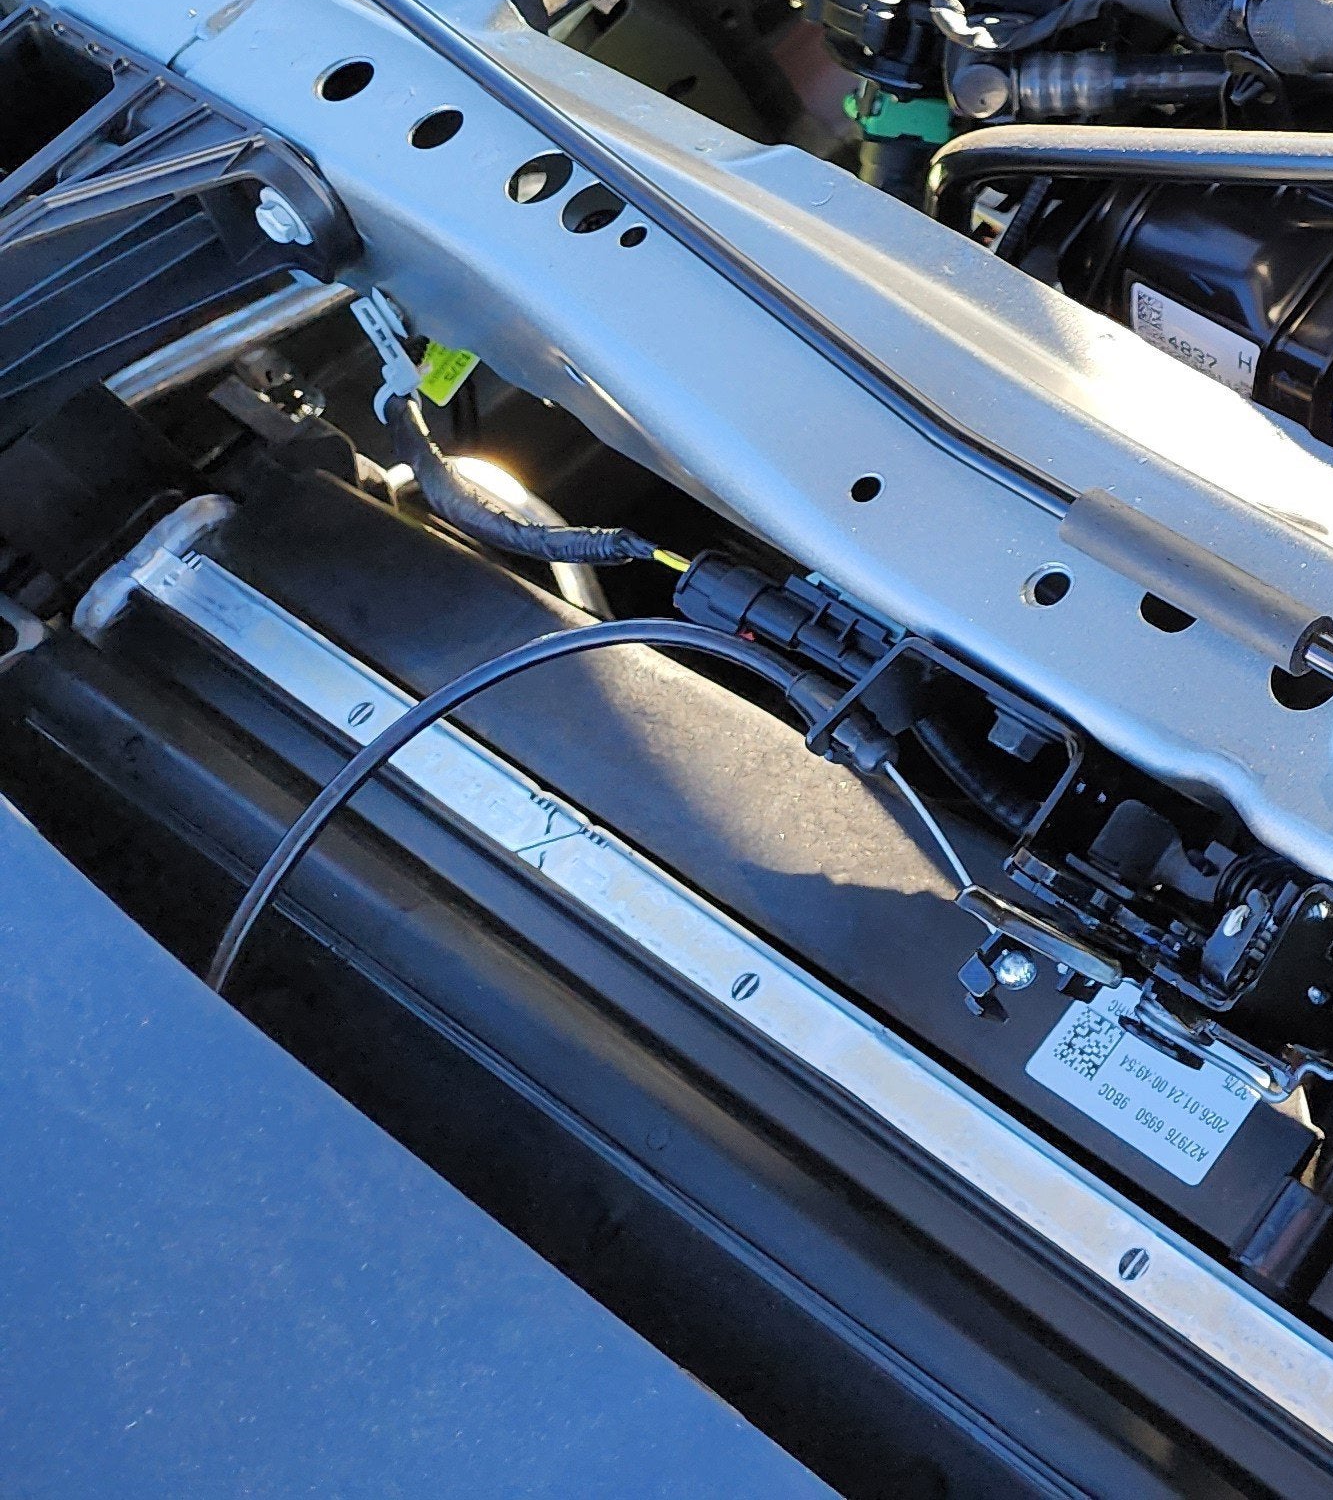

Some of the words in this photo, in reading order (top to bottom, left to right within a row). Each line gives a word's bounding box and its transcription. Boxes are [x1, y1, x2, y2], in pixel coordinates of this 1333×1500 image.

[1120, 1054, 1169, 1094] 00:49:54
[1135, 1107, 1165, 1133] 6950
[1173, 1088, 1229, 1134] 2026.01.24
[1164, 1127, 1209, 1162] A27976
